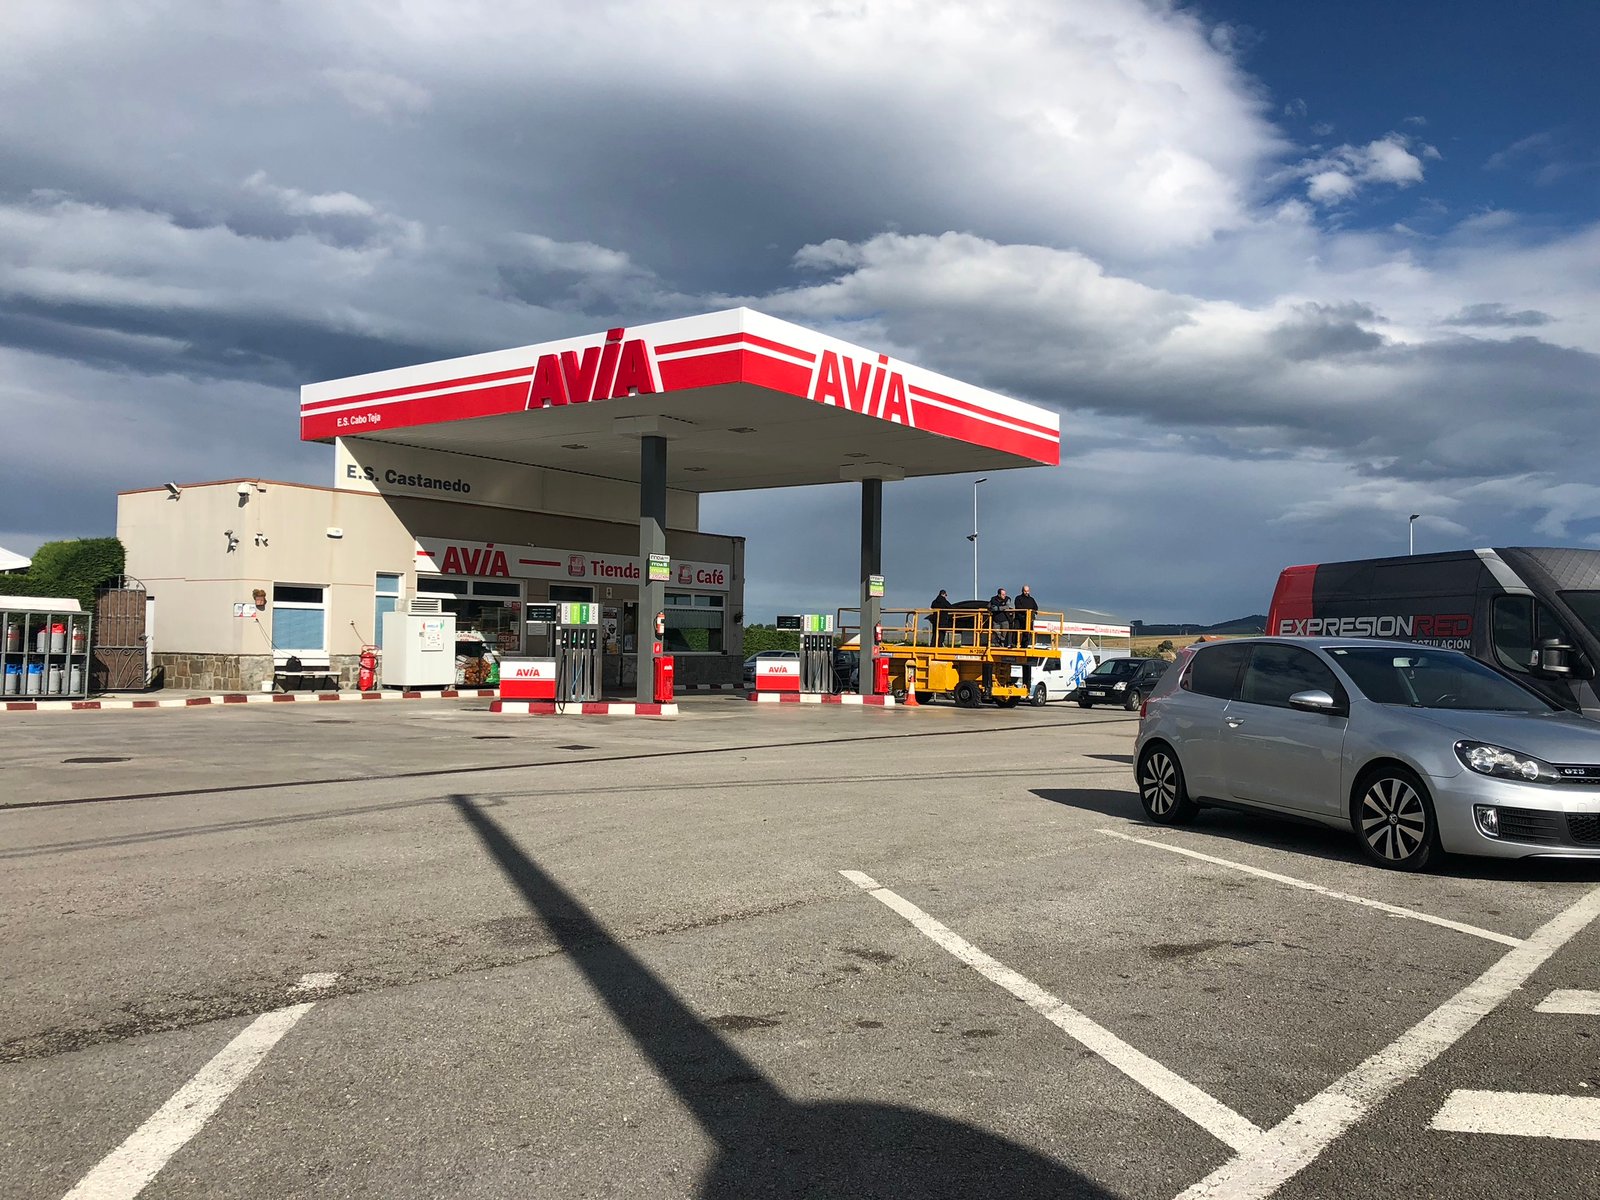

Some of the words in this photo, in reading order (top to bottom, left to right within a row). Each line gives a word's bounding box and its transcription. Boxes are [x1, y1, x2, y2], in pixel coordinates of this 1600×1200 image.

[337, 417, 349, 427] E.S.
[350, 415, 367, 426] Cabo
[368, 413, 381, 424] Teja
[346, 464, 380, 482] E.S.
[385, 469, 471, 493] Castanedo
[591, 560, 640, 579] Tienda
[696, 569, 724, 585] Café
